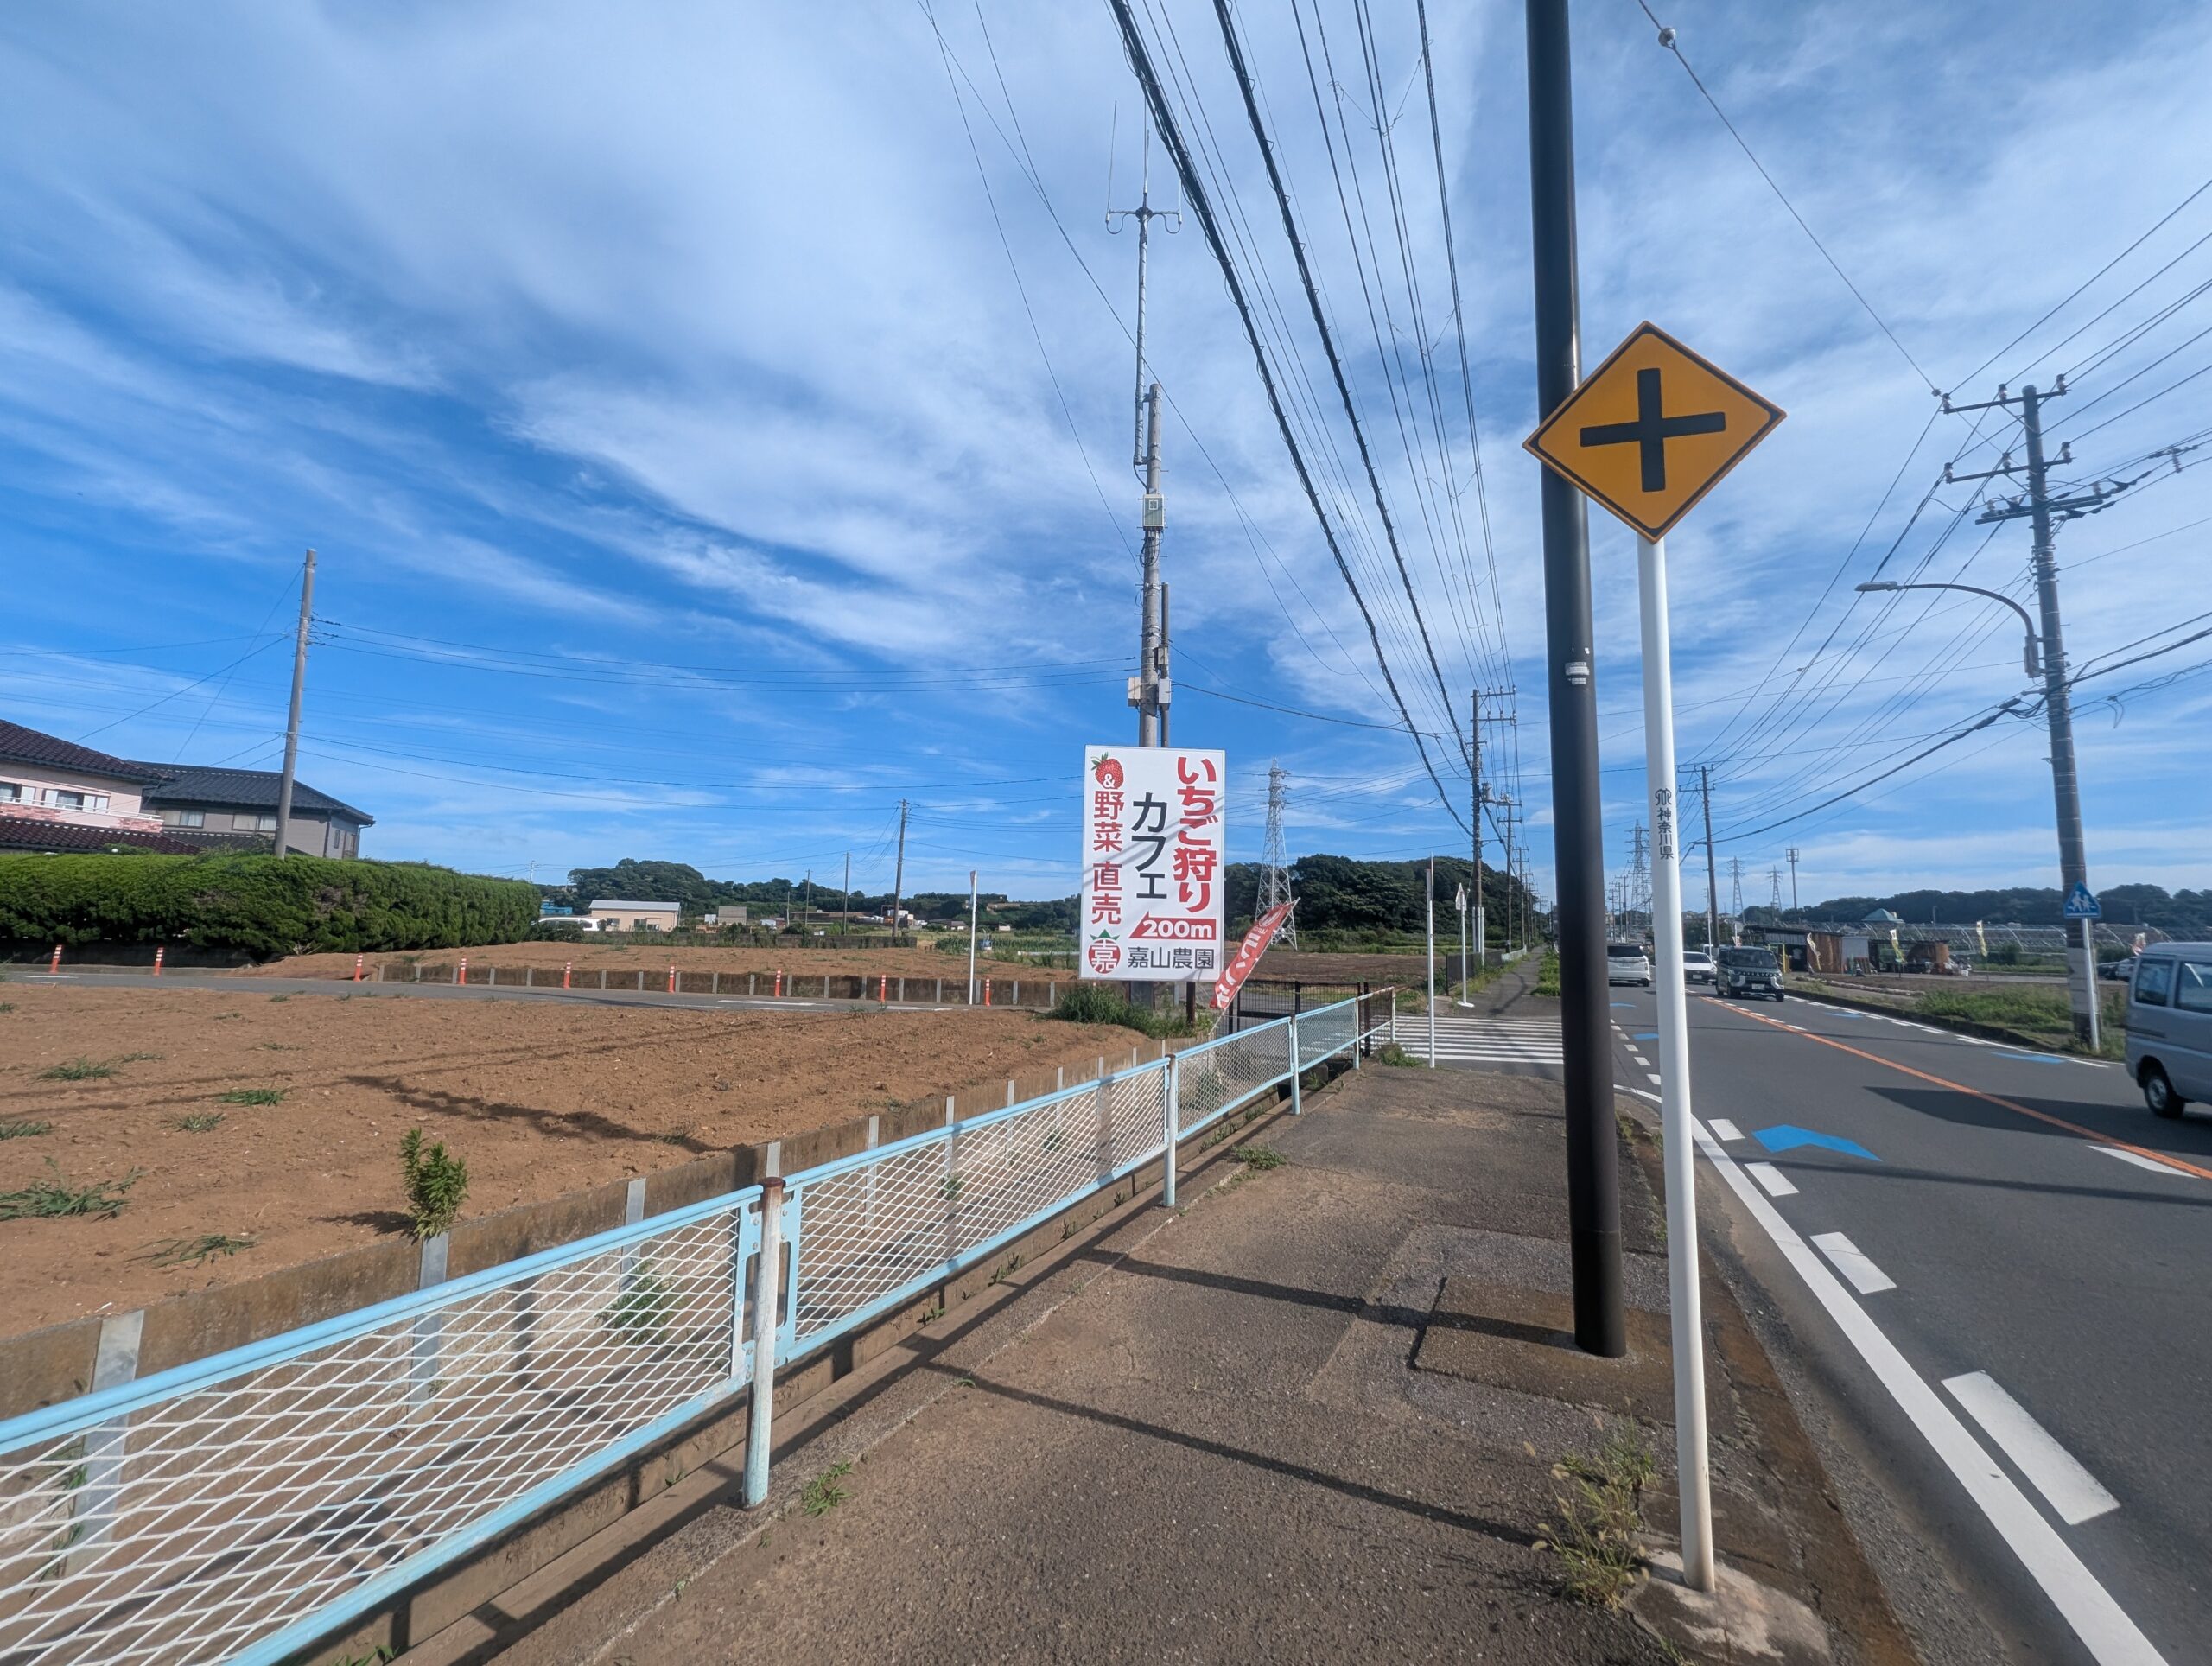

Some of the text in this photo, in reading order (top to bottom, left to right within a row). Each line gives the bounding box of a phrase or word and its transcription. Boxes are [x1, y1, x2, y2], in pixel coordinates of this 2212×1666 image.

[1131, 792, 1167, 900] カフェ
[1173, 756, 1218, 913] いちご狩り
[1656, 807, 1674, 860] 神奈川県
[1141, 920, 1213, 938] 200m
[1128, 946, 1215, 970] 嘉山農園
